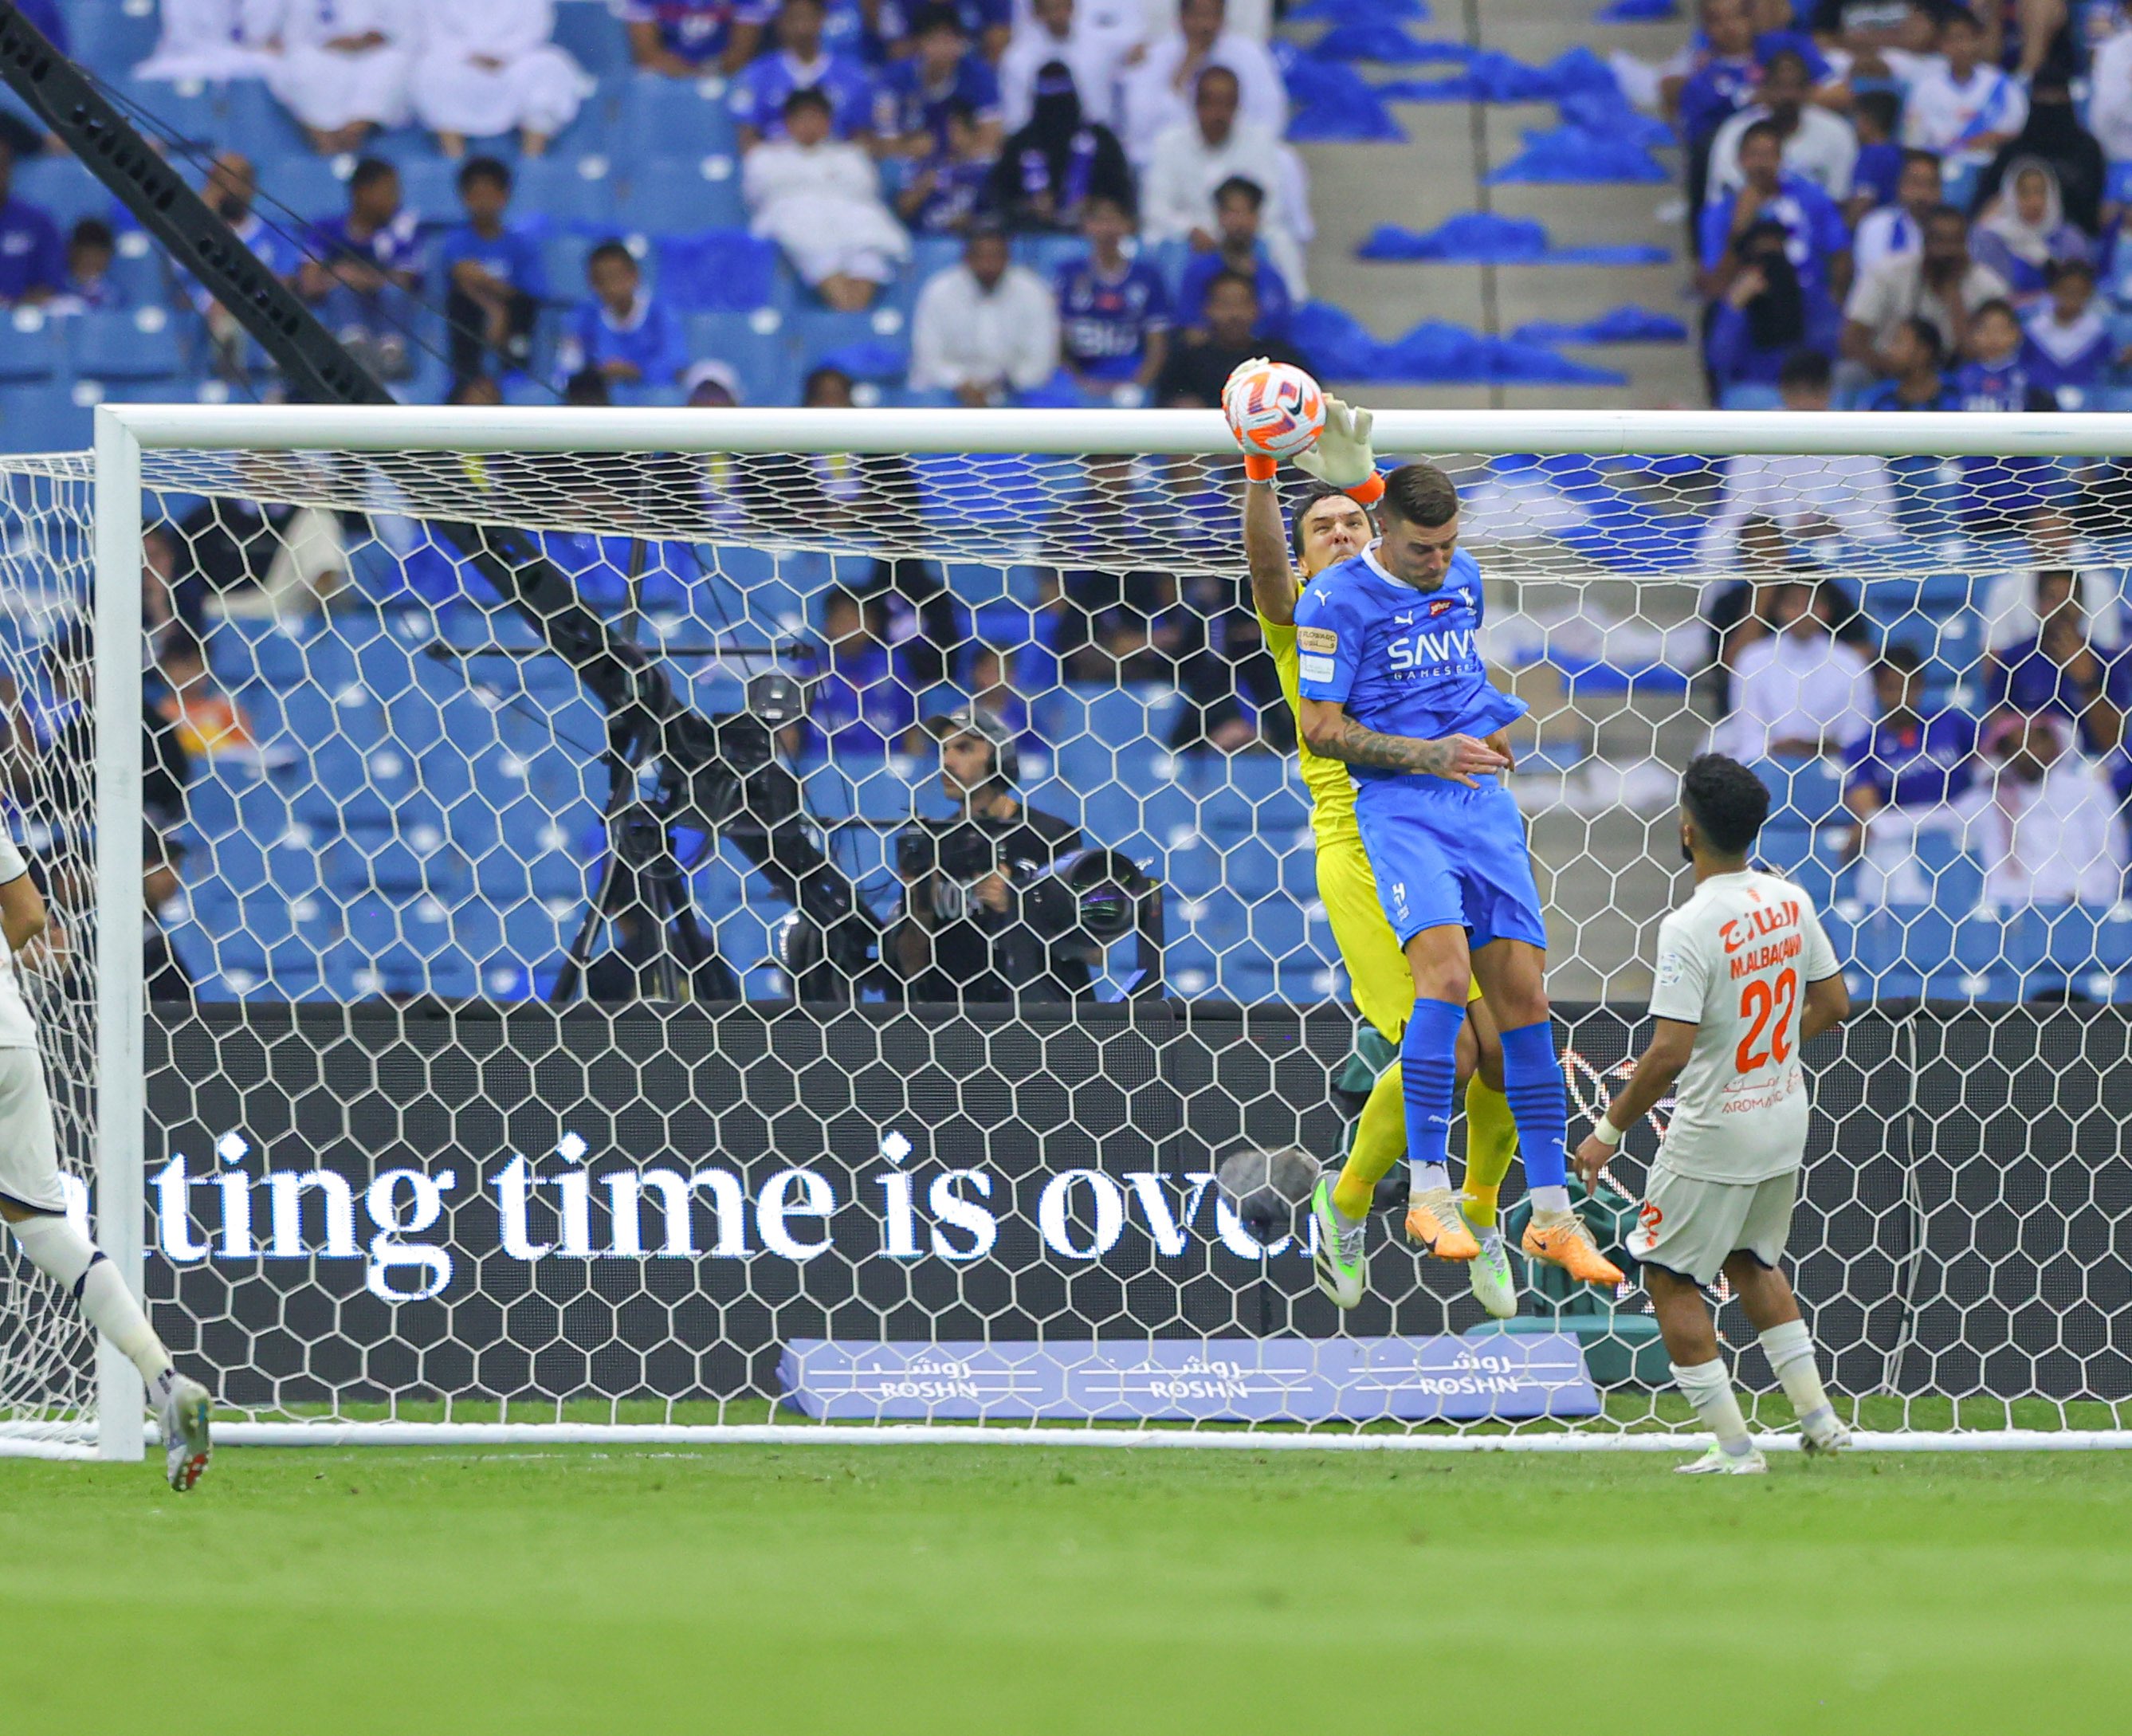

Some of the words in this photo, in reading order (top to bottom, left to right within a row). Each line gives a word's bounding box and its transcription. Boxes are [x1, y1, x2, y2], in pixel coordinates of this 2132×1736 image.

[1393, 665, 1451, 681] GAMES
[1719, 901, 1800, 954] الطازج
[1735, 967, 1797, 1074] 22
[14, 1132, 455, 1302] ting
[487, 1132, 836, 1262] time
[875, 1131, 997, 1262] is
[880, 1381, 980, 1399] ROSHN
[1149, 1381, 1249, 1399] ROSHN
[1419, 1374, 1519, 1396] ROSHN
